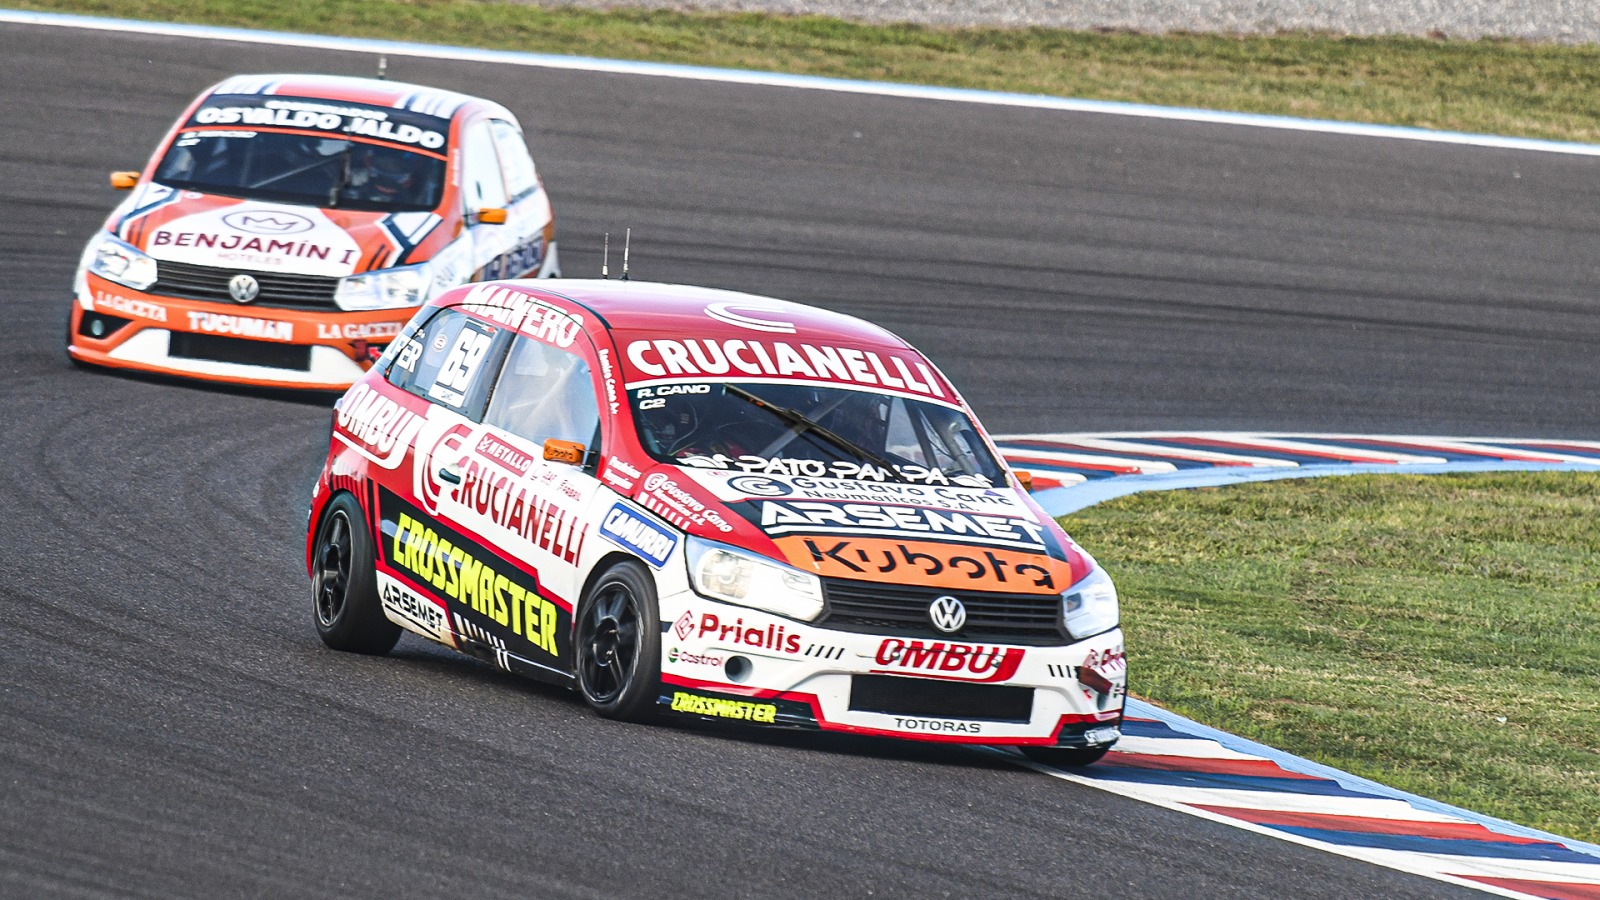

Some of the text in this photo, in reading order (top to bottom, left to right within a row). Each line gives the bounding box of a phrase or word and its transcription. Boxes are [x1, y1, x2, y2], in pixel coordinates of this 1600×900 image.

[196, 106, 446, 149] OSVALDO JALDO
[154, 230, 331, 261] BENJAMÍN
[317, 323, 342, 339] LA
[461, 283, 584, 348] MAINERO
[435, 327, 493, 393] 69
[626, 338, 945, 399] CRUCIANELLI
[636, 384, 711, 399] R. CANO
[638, 398, 666, 411] C2
[337, 382, 410, 454] OMBU
[488, 441, 532, 473] METALLO
[734, 455, 826, 477] PATO
[792, 477, 925, 497] Gustavo
[802, 489, 934, 508] Neumáticos
[661, 480, 734, 533] Gustavo Cano
[761, 500, 1046, 546] ARSEMET
[603, 508, 675, 562] CAMURRI
[803, 540, 1054, 590] Kubota
[393, 512, 559, 657] CROSSMASTER
[383, 582, 444, 634] ARSEMET
[698, 613, 801, 654] Prialis
[679, 651, 724, 667] Castrol
[875, 638, 1000, 674] OMBU
[671, 691, 778, 723] CROSSMASTER
[894, 717, 982, 734] TOTORAS
